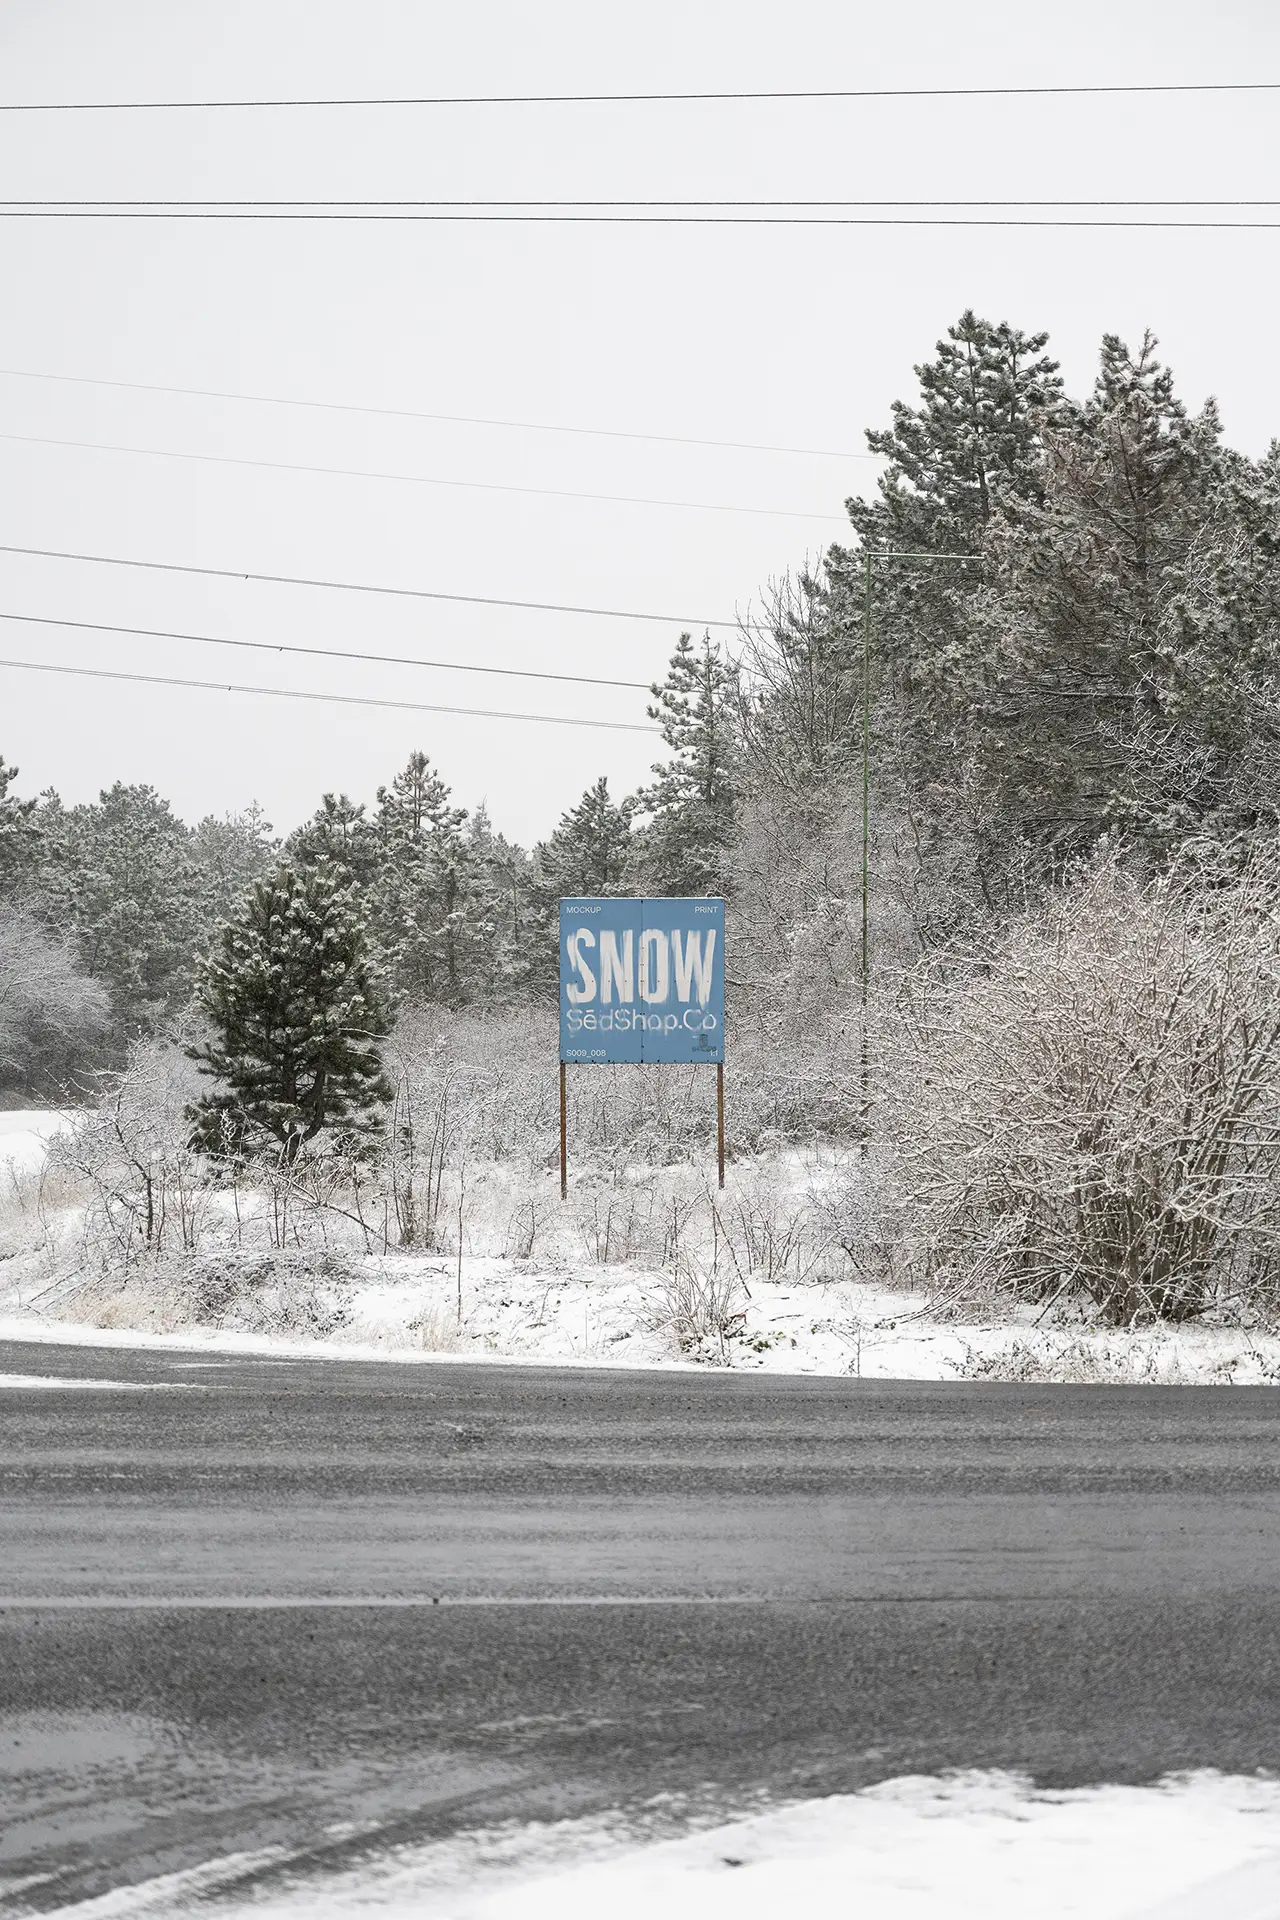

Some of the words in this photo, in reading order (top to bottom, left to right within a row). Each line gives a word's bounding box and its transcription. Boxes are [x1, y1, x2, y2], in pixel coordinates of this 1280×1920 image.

[566, 906, 602, 914] MOCKUP
[695, 906, 718, 914] PRINT
[566, 928, 717, 1003] SNOW
[566, 1049, 607, 1058] S009_008
